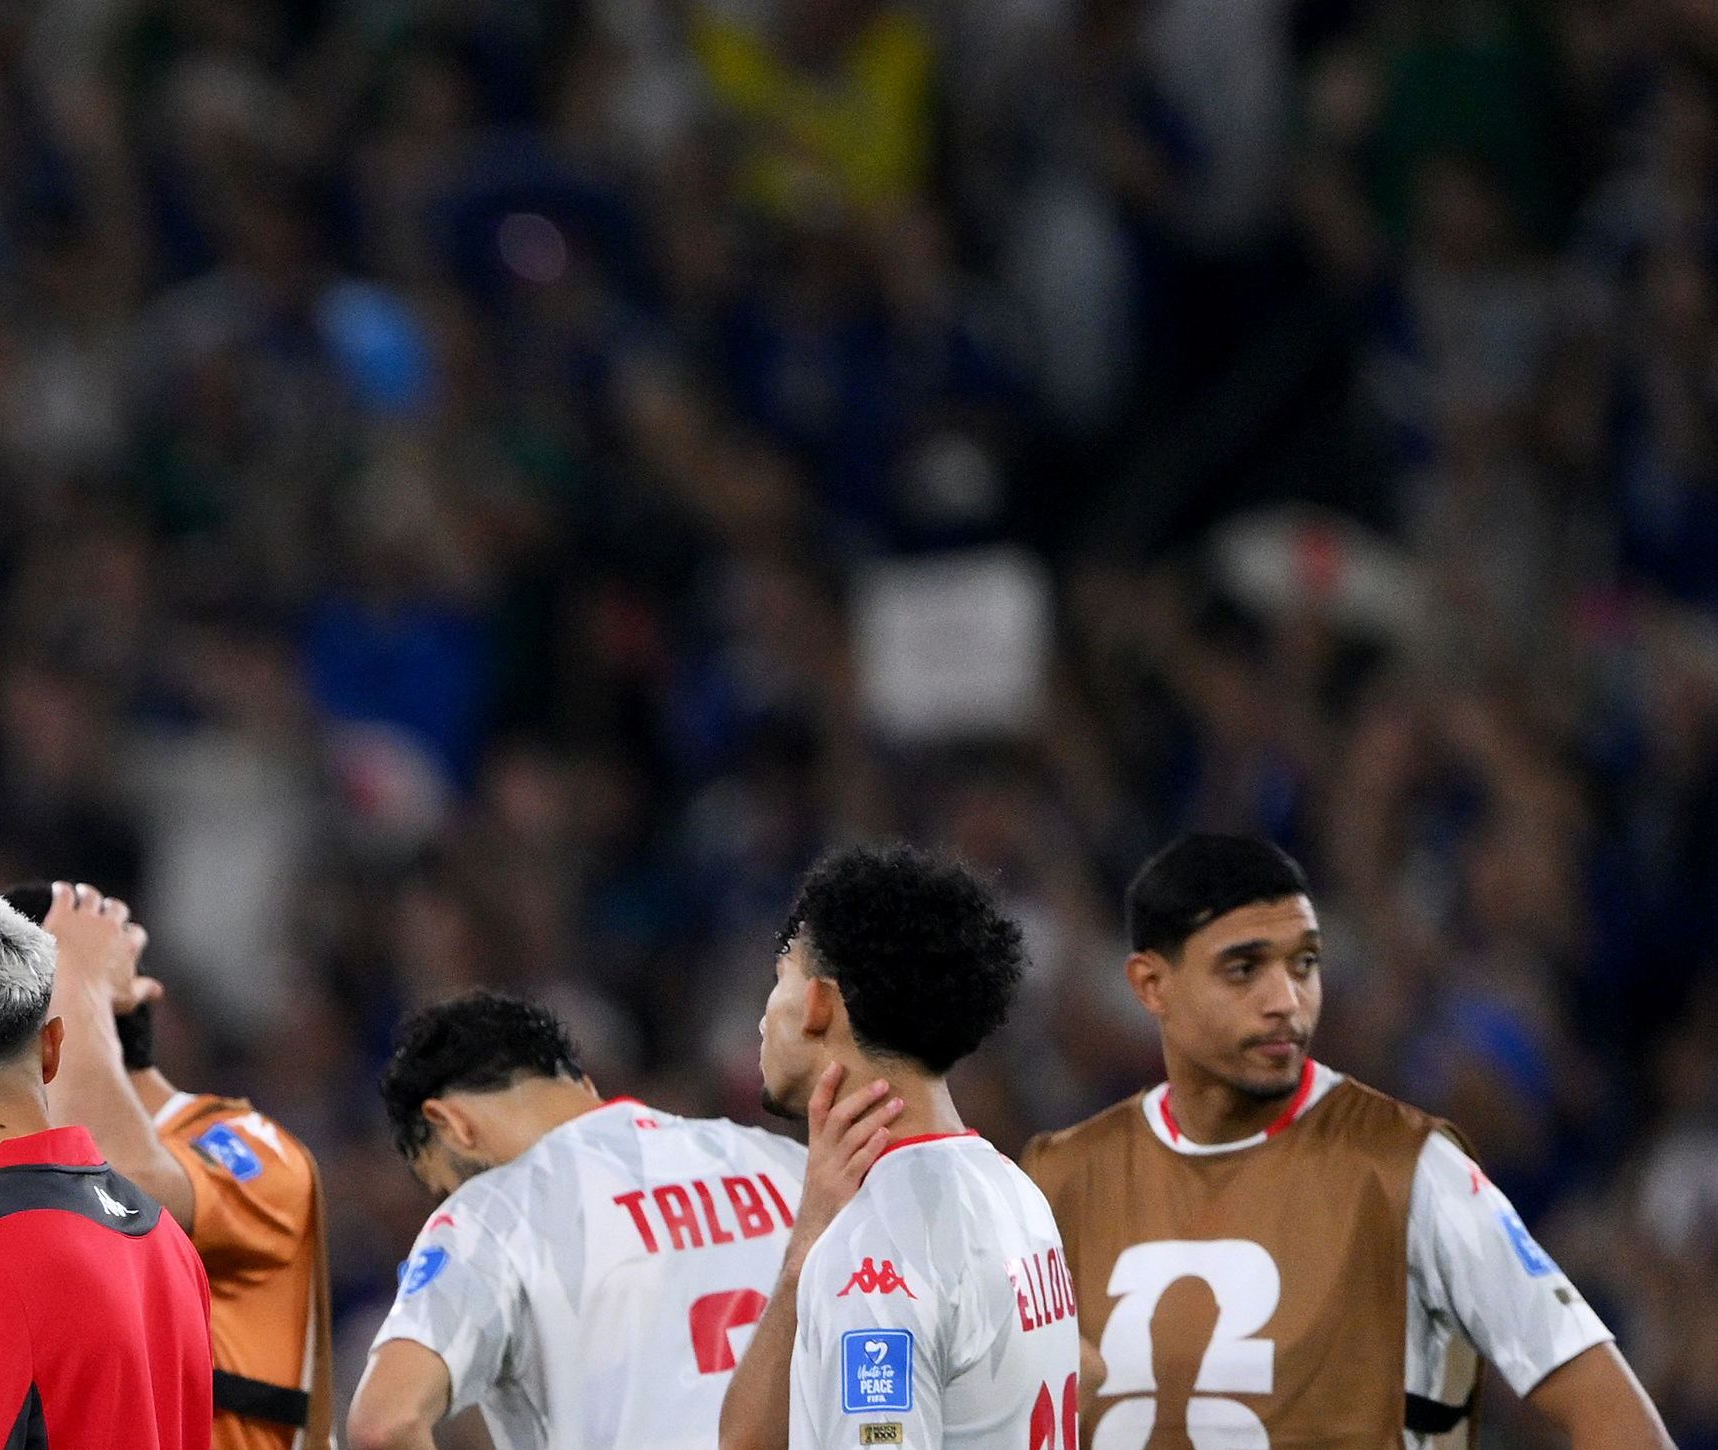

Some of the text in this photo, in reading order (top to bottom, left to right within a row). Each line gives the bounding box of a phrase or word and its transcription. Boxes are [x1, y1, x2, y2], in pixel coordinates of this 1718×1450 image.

[613, 1172, 796, 1254] TALBI
[860, 1379, 894, 1394] PEACE
[866, 1394, 887, 1402] FIFA
